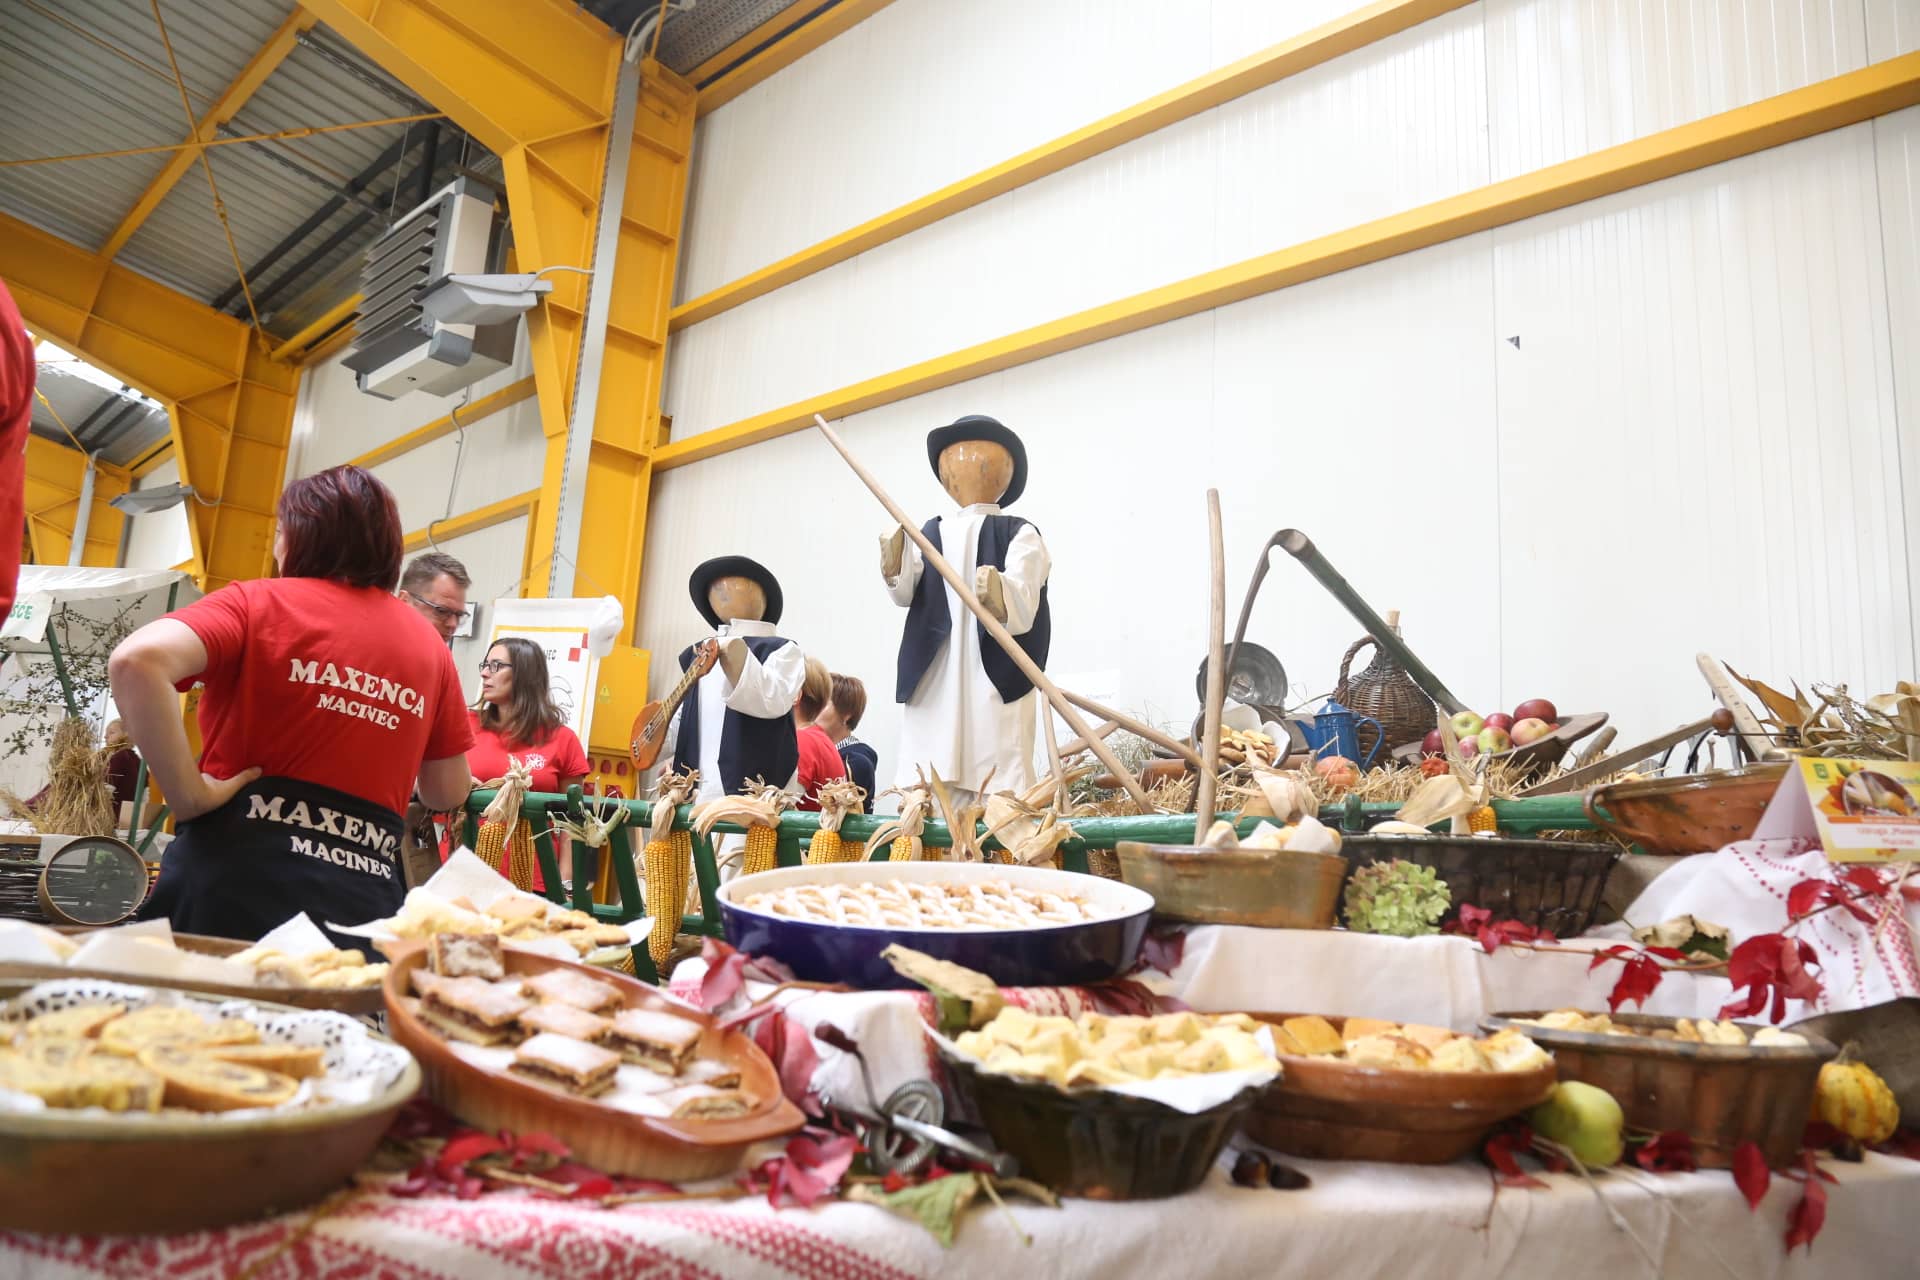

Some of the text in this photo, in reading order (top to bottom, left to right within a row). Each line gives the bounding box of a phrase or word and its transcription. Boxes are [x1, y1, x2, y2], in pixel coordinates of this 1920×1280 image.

[288, 658, 425, 719] MAXENCA
[316, 693, 400, 730] MACINEC
[290, 835, 392, 880] MACINEC
